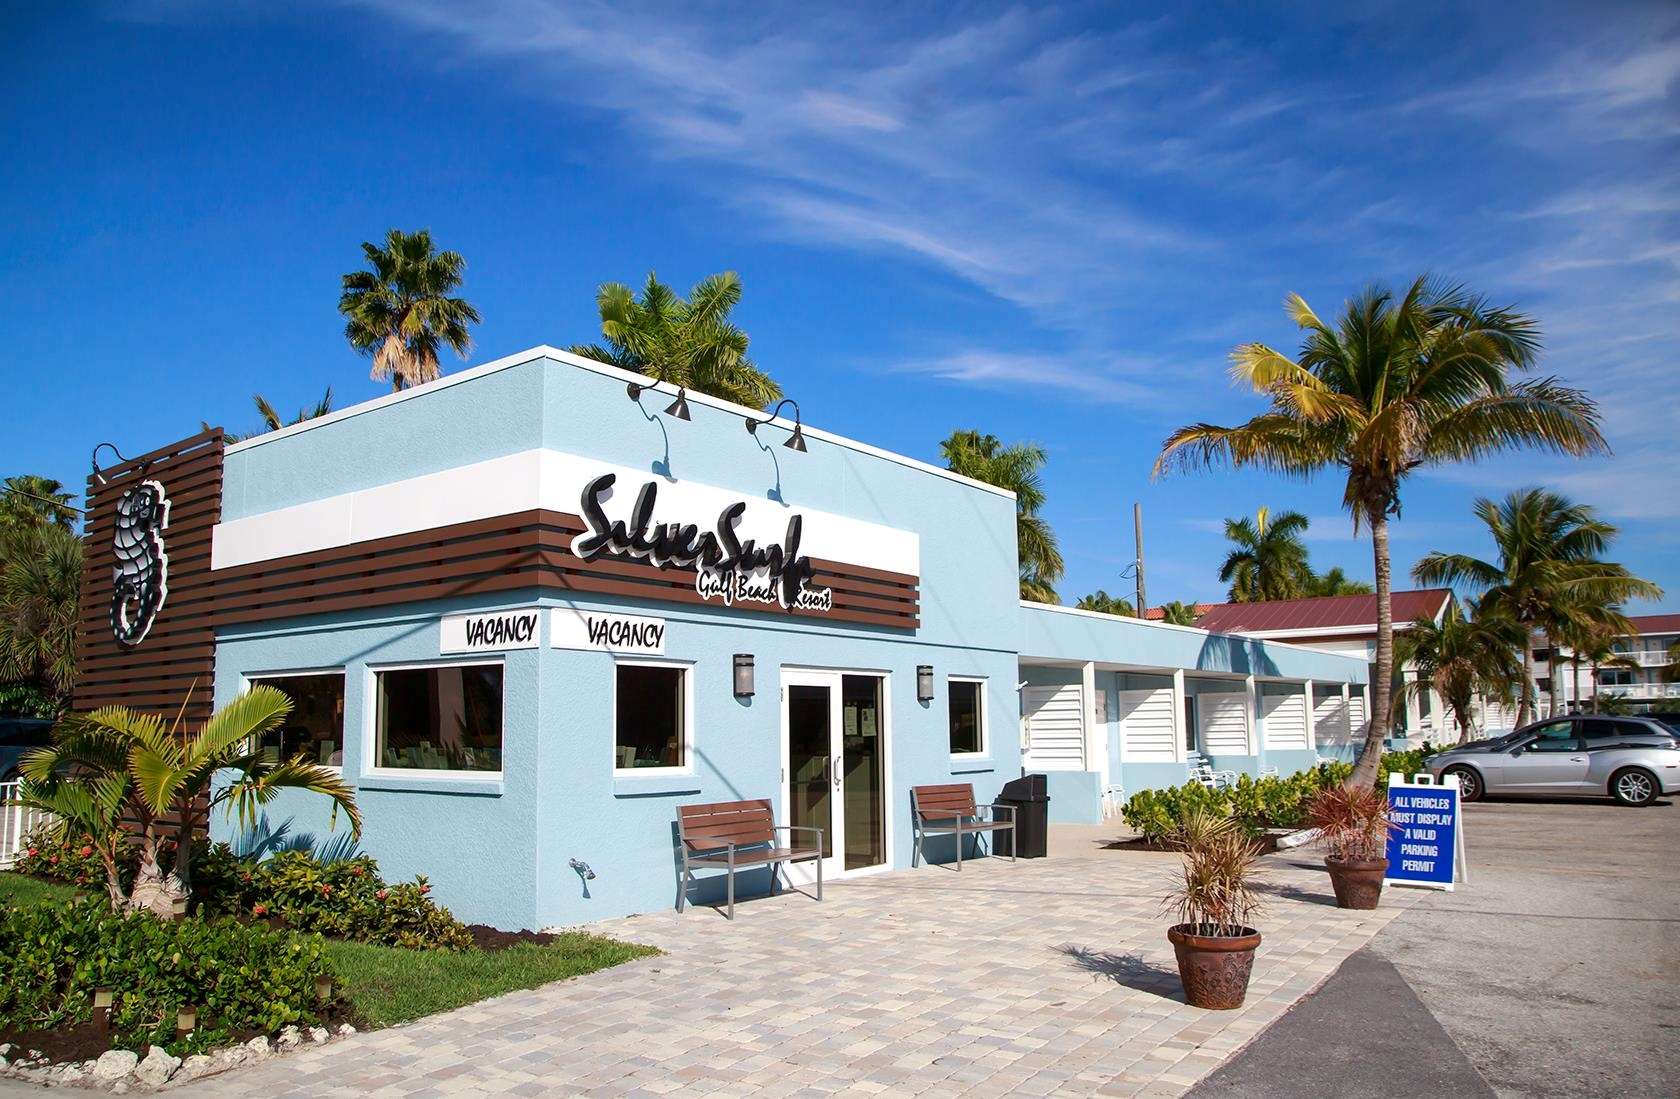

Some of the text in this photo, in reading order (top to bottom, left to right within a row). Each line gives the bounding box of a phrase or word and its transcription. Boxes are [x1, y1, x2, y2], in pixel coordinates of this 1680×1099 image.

[578, 473, 815, 608] Silver Surf
[699, 570, 732, 605] Gulf
[738, 574, 777, 600] Beach
[466, 614, 537, 647] VACANCY
[588, 616, 665, 648] VACANCY
[1395, 796, 1449, 809] ALL VEHICLES
[1391, 812, 1452, 825] MUST DISPLAY
[1404, 828, 1436, 840] A VALID
[1401, 844, 1438, 856] PARKING
[1402, 860, 1435, 872] PERMIT
